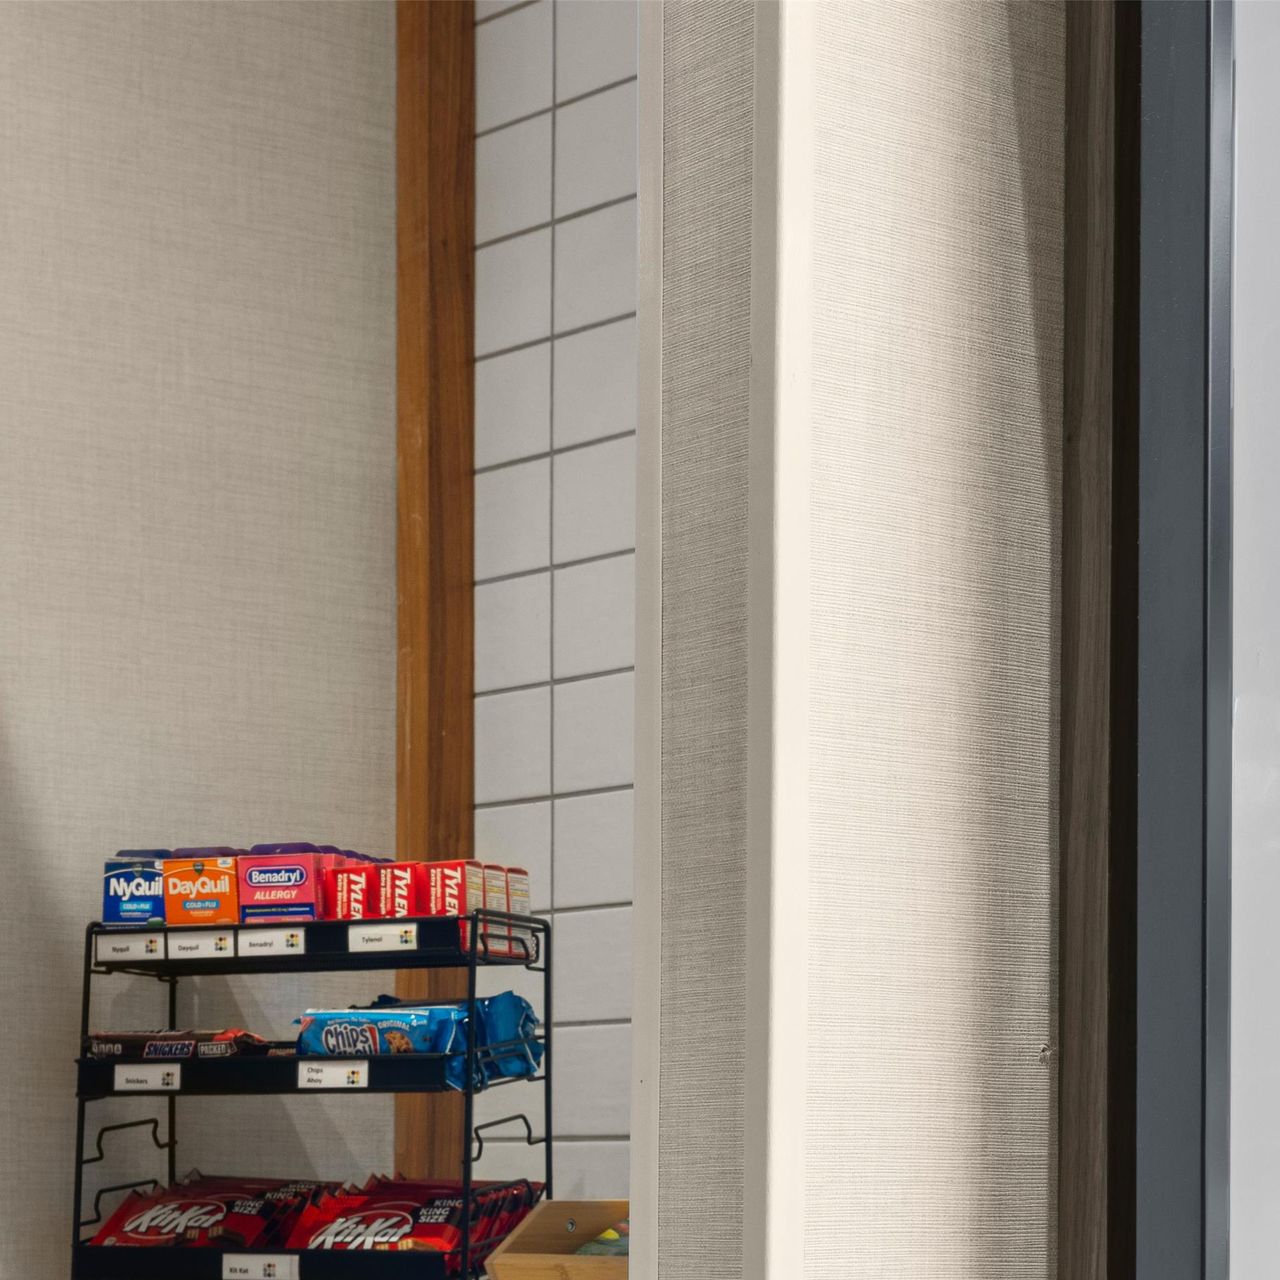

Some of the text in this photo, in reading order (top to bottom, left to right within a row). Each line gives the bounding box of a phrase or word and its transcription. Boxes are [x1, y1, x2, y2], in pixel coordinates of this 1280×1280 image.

[251, 869, 300, 884] Benadryl
[109, 876, 163, 901] NyQuil
[168, 876, 229, 898] DayQuil
[254, 890, 297, 900] ALLERGY
[378, 1021, 410, 1031] ORIGINAL
[323, 1025, 370, 1053] Chips
[145, 1041, 194, 1057] SNICKERS
[307, 1067, 323, 1075] Chips
[234, 1200, 264, 1208] KING
[232, 1206, 259, 1215] SIZE
[123, 1203, 225, 1233] KitKat
[418, 1215, 447, 1223] SIZE
